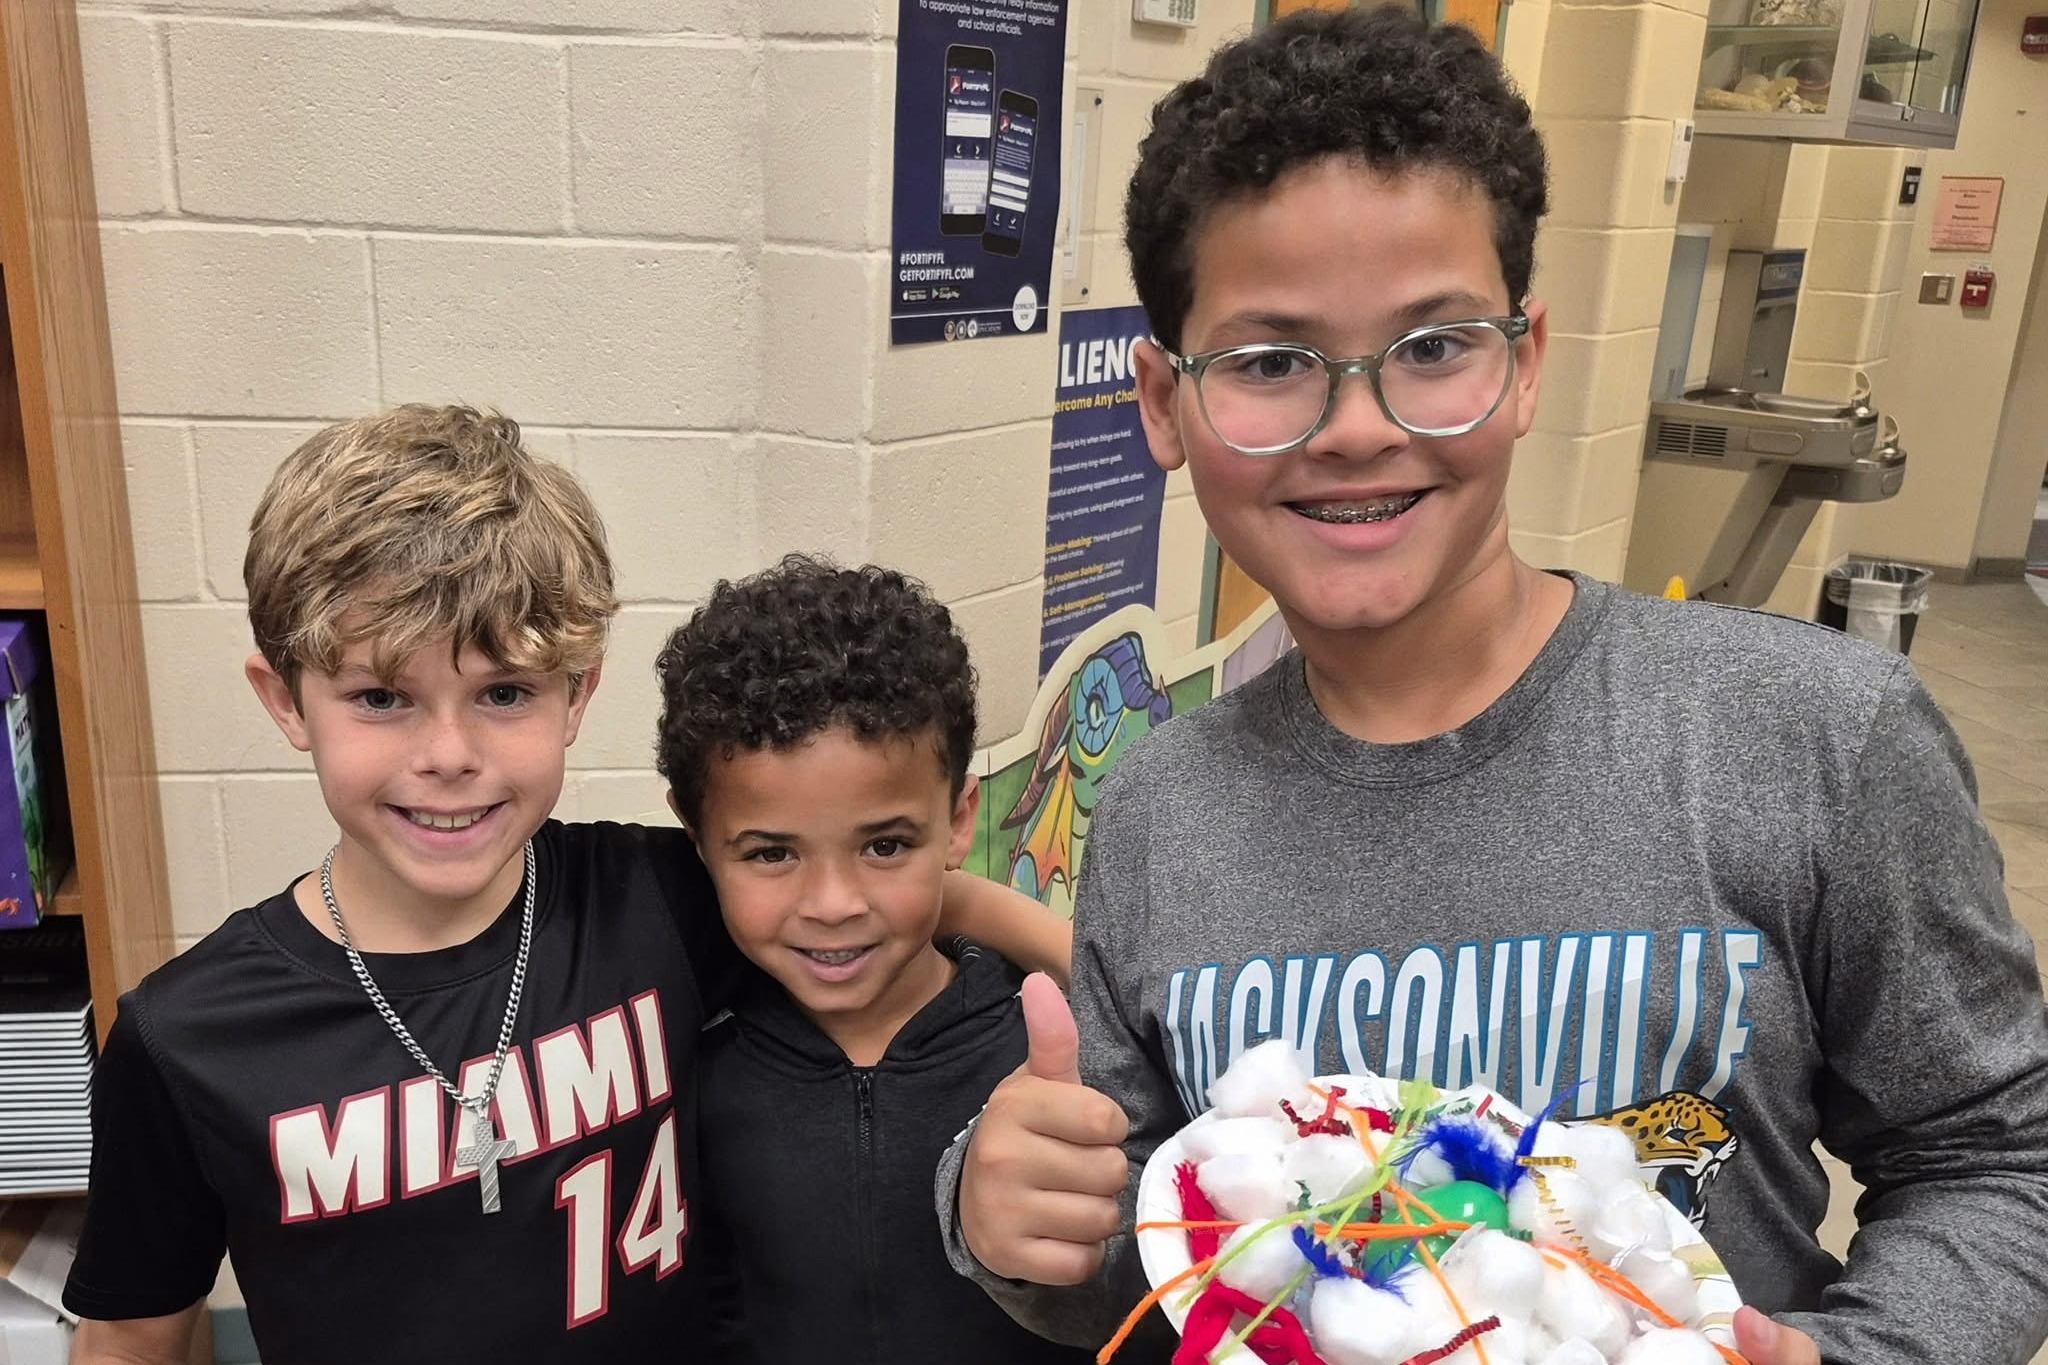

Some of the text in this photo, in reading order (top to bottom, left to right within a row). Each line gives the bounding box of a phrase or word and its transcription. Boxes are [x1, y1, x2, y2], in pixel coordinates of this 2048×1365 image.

[928, 0, 970, 14] appropriate
[972, 5, 984, 16] law
[986, 8, 1026, 22] enforcement
[1028, 15, 1055, 26] agencies
[1025, 0, 1059, 12] information
[958, 18, 972, 29] and
[973, 20, 995, 32] school
[900, 252, 944, 265] #FORTIFYFL
[899, 267, 974, 282] GETFORTIFYFL.COM
[1060, 335, 1150, 388] LIENC
[1094, 392, 1114, 409] Any
[269, 988, 672, 1224] MIAMI
[554, 1106, 688, 1330] 14
